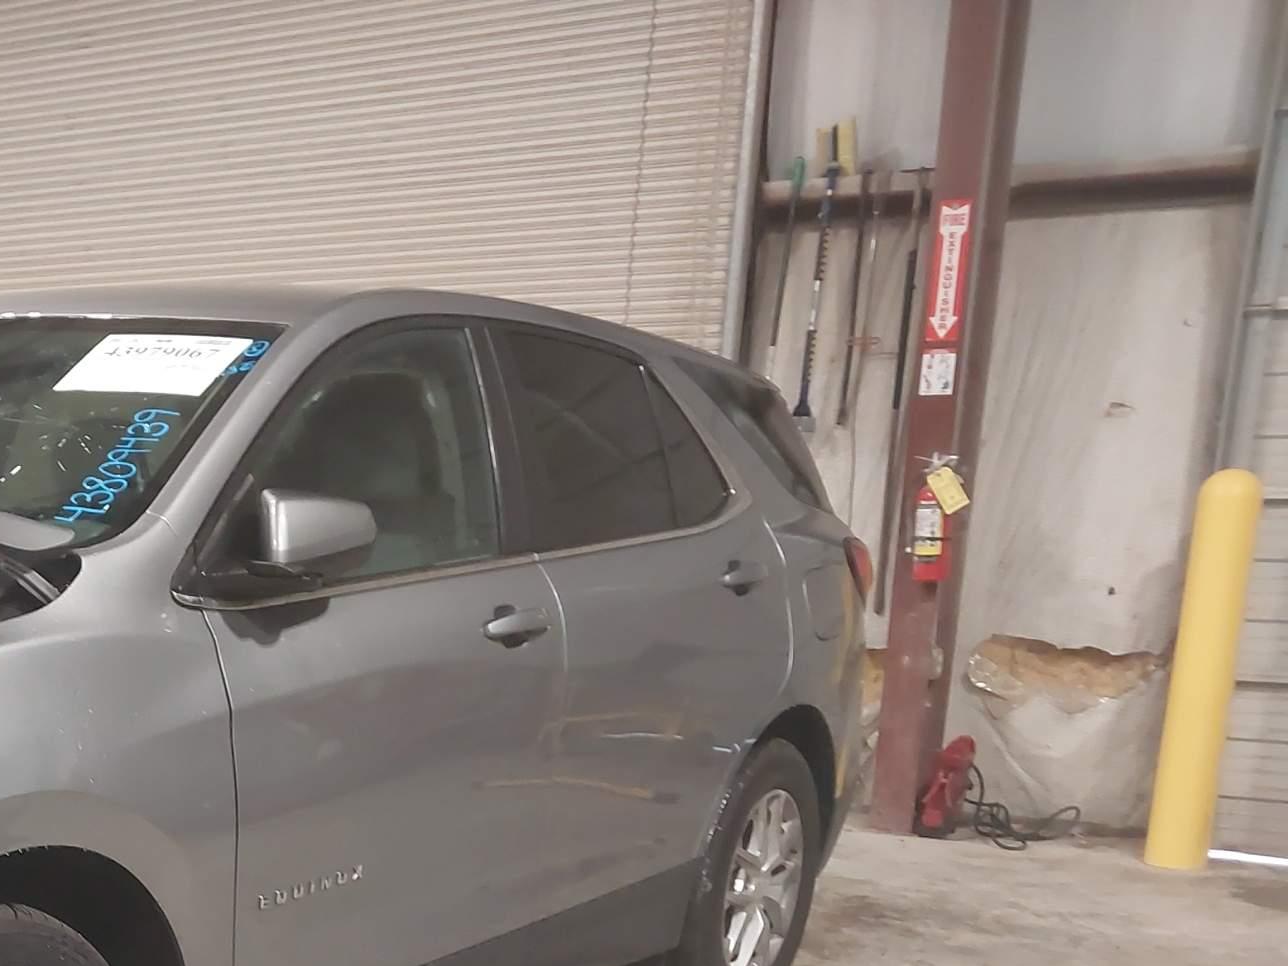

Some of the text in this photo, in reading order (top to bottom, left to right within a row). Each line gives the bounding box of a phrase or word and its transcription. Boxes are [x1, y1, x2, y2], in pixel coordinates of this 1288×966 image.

[938, 231, 957, 330] EXTINGUISHER
[53, 408, 181, 523] 43809439
[257, 864, 364, 911] EQUINOX
